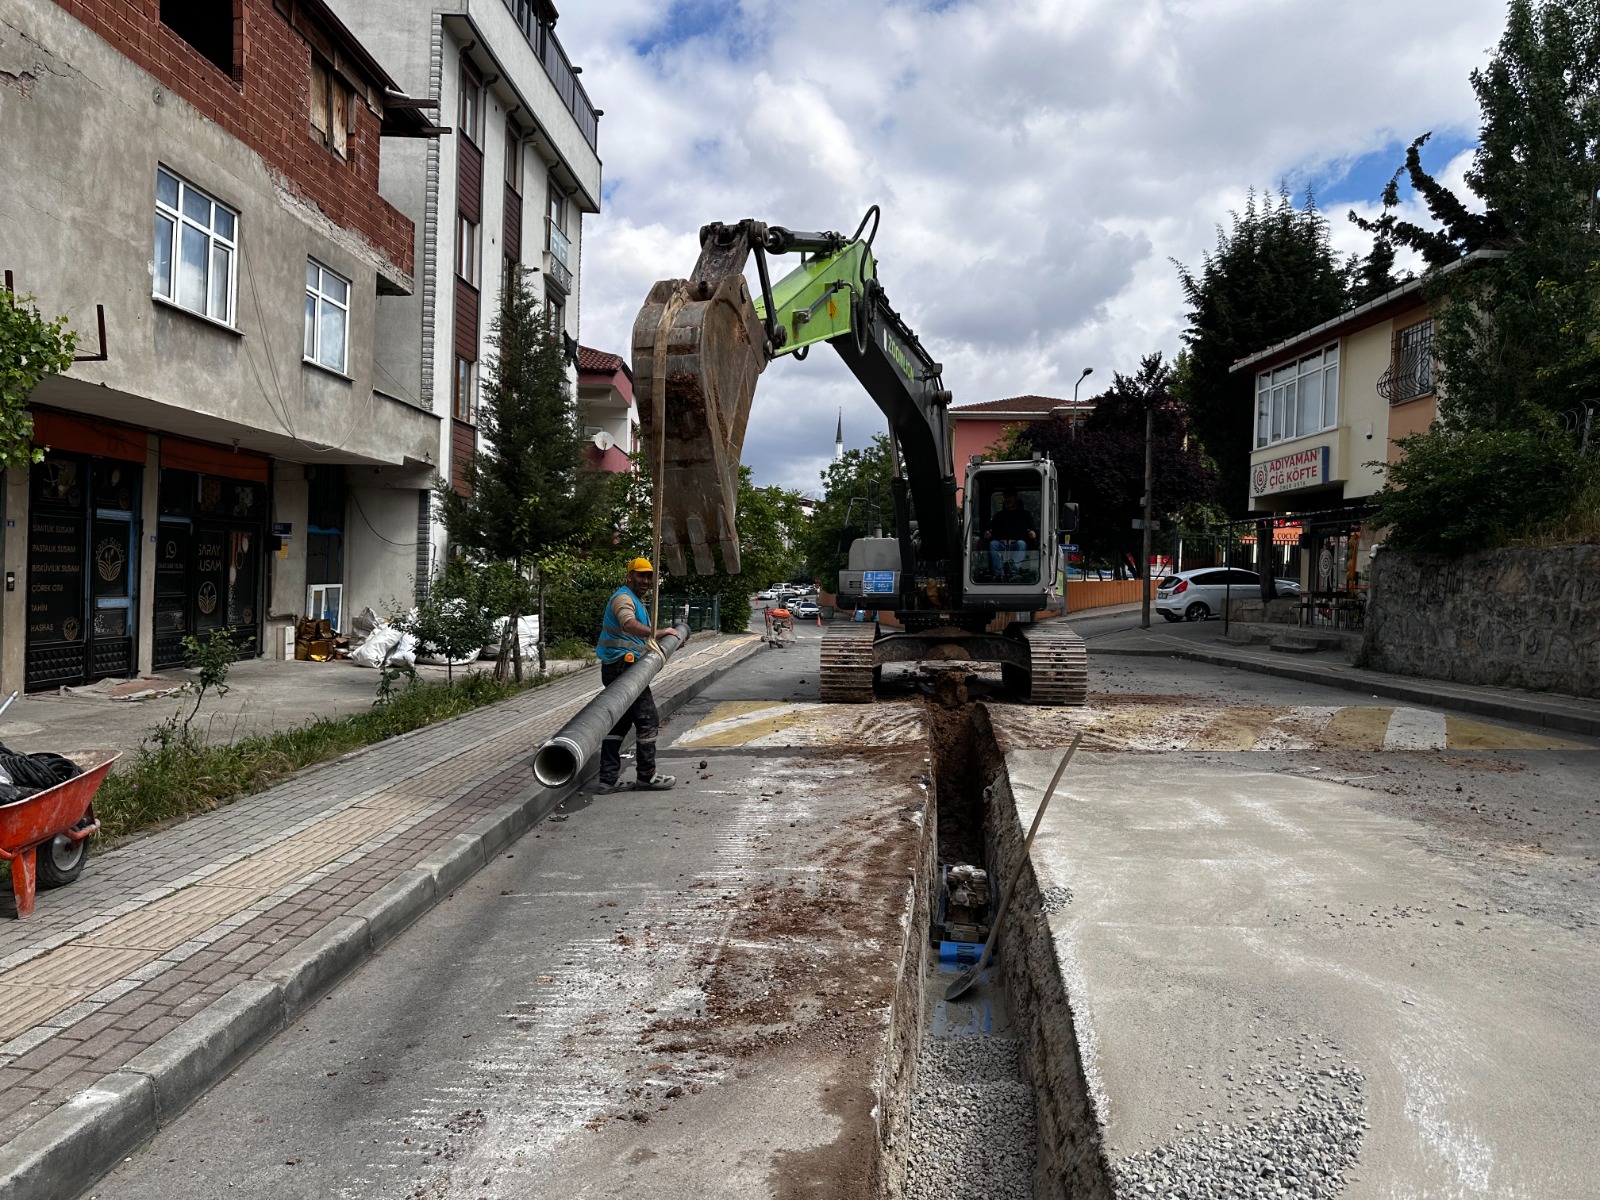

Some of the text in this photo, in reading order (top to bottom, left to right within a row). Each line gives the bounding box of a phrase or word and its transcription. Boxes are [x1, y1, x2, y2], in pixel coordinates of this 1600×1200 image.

[1270, 450, 1317, 472] ADIYAMAN
[1270, 466, 1317, 489] ÇİĞ KÖFTE
[57, 544, 76, 553] SUSAM
[61, 563, 80, 573] SUSAM
[198, 559, 222, 571] USAM
